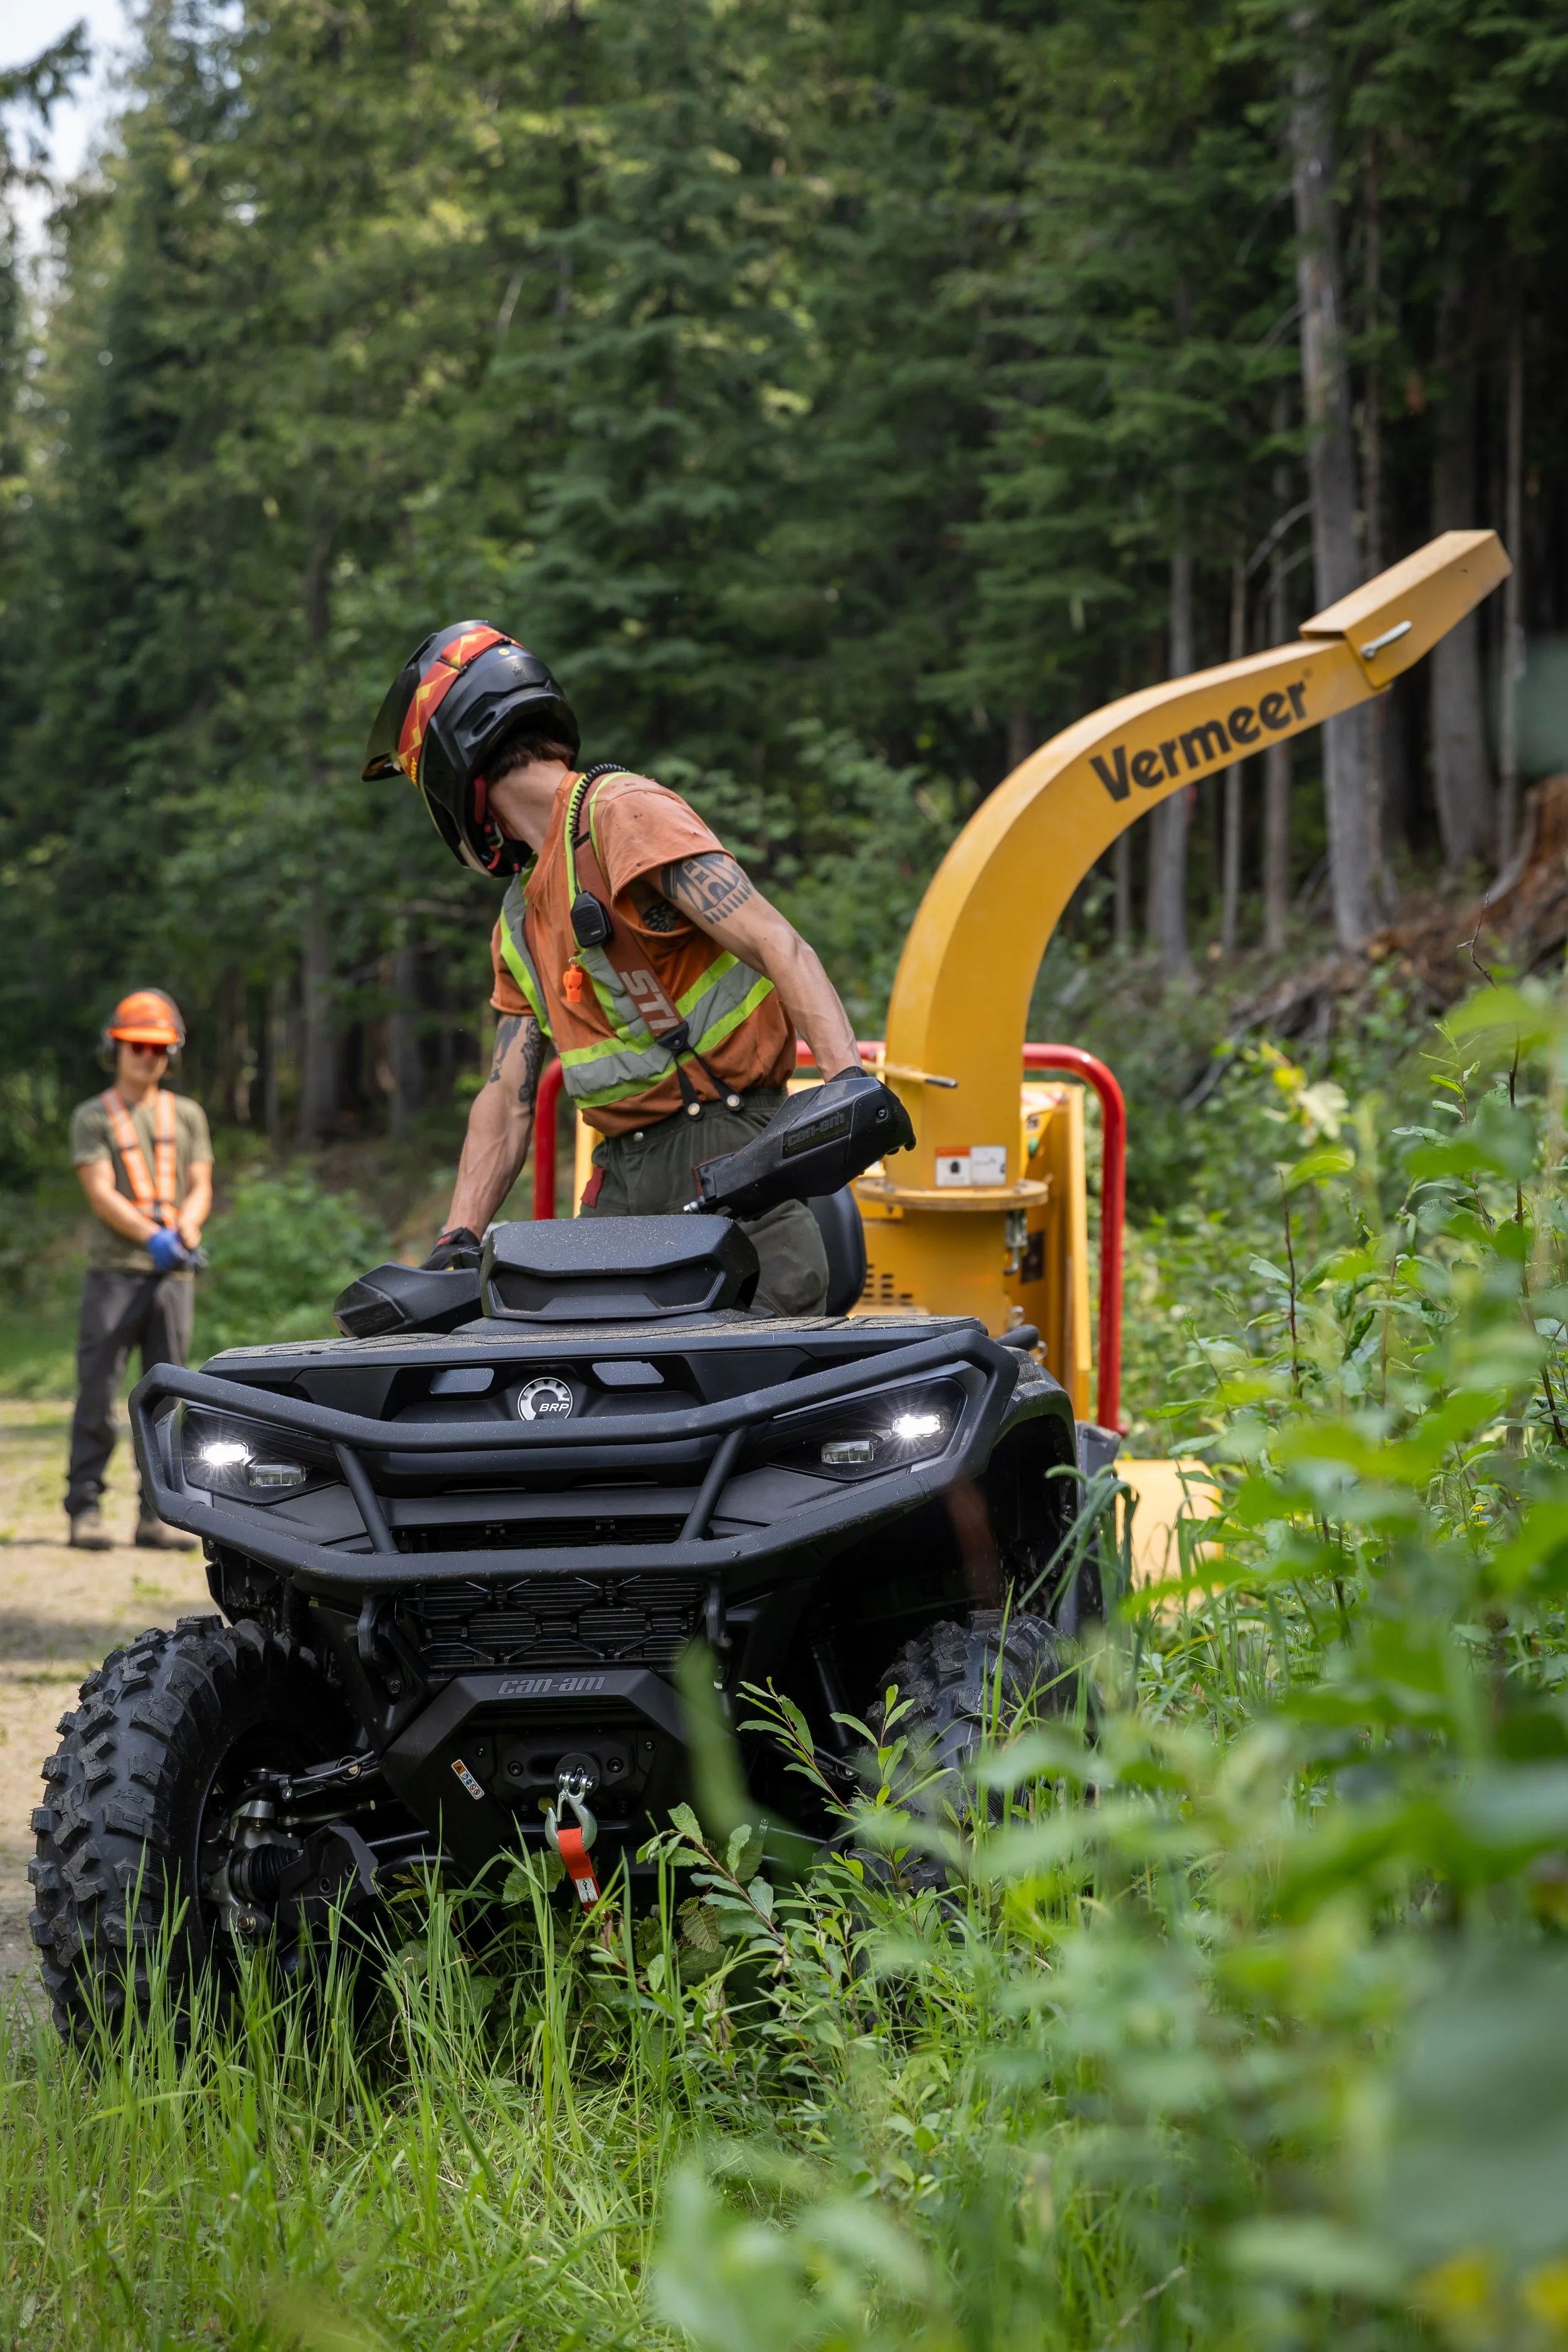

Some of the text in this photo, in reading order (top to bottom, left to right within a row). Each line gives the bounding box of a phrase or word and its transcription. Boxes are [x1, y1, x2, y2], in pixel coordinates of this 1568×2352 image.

[1089, 681, 1306, 802] Vermeer
[619, 970, 680, 1036] STI
[539, 1403, 569, 1412] BRP
[497, 1676, 606, 1694] can-am
